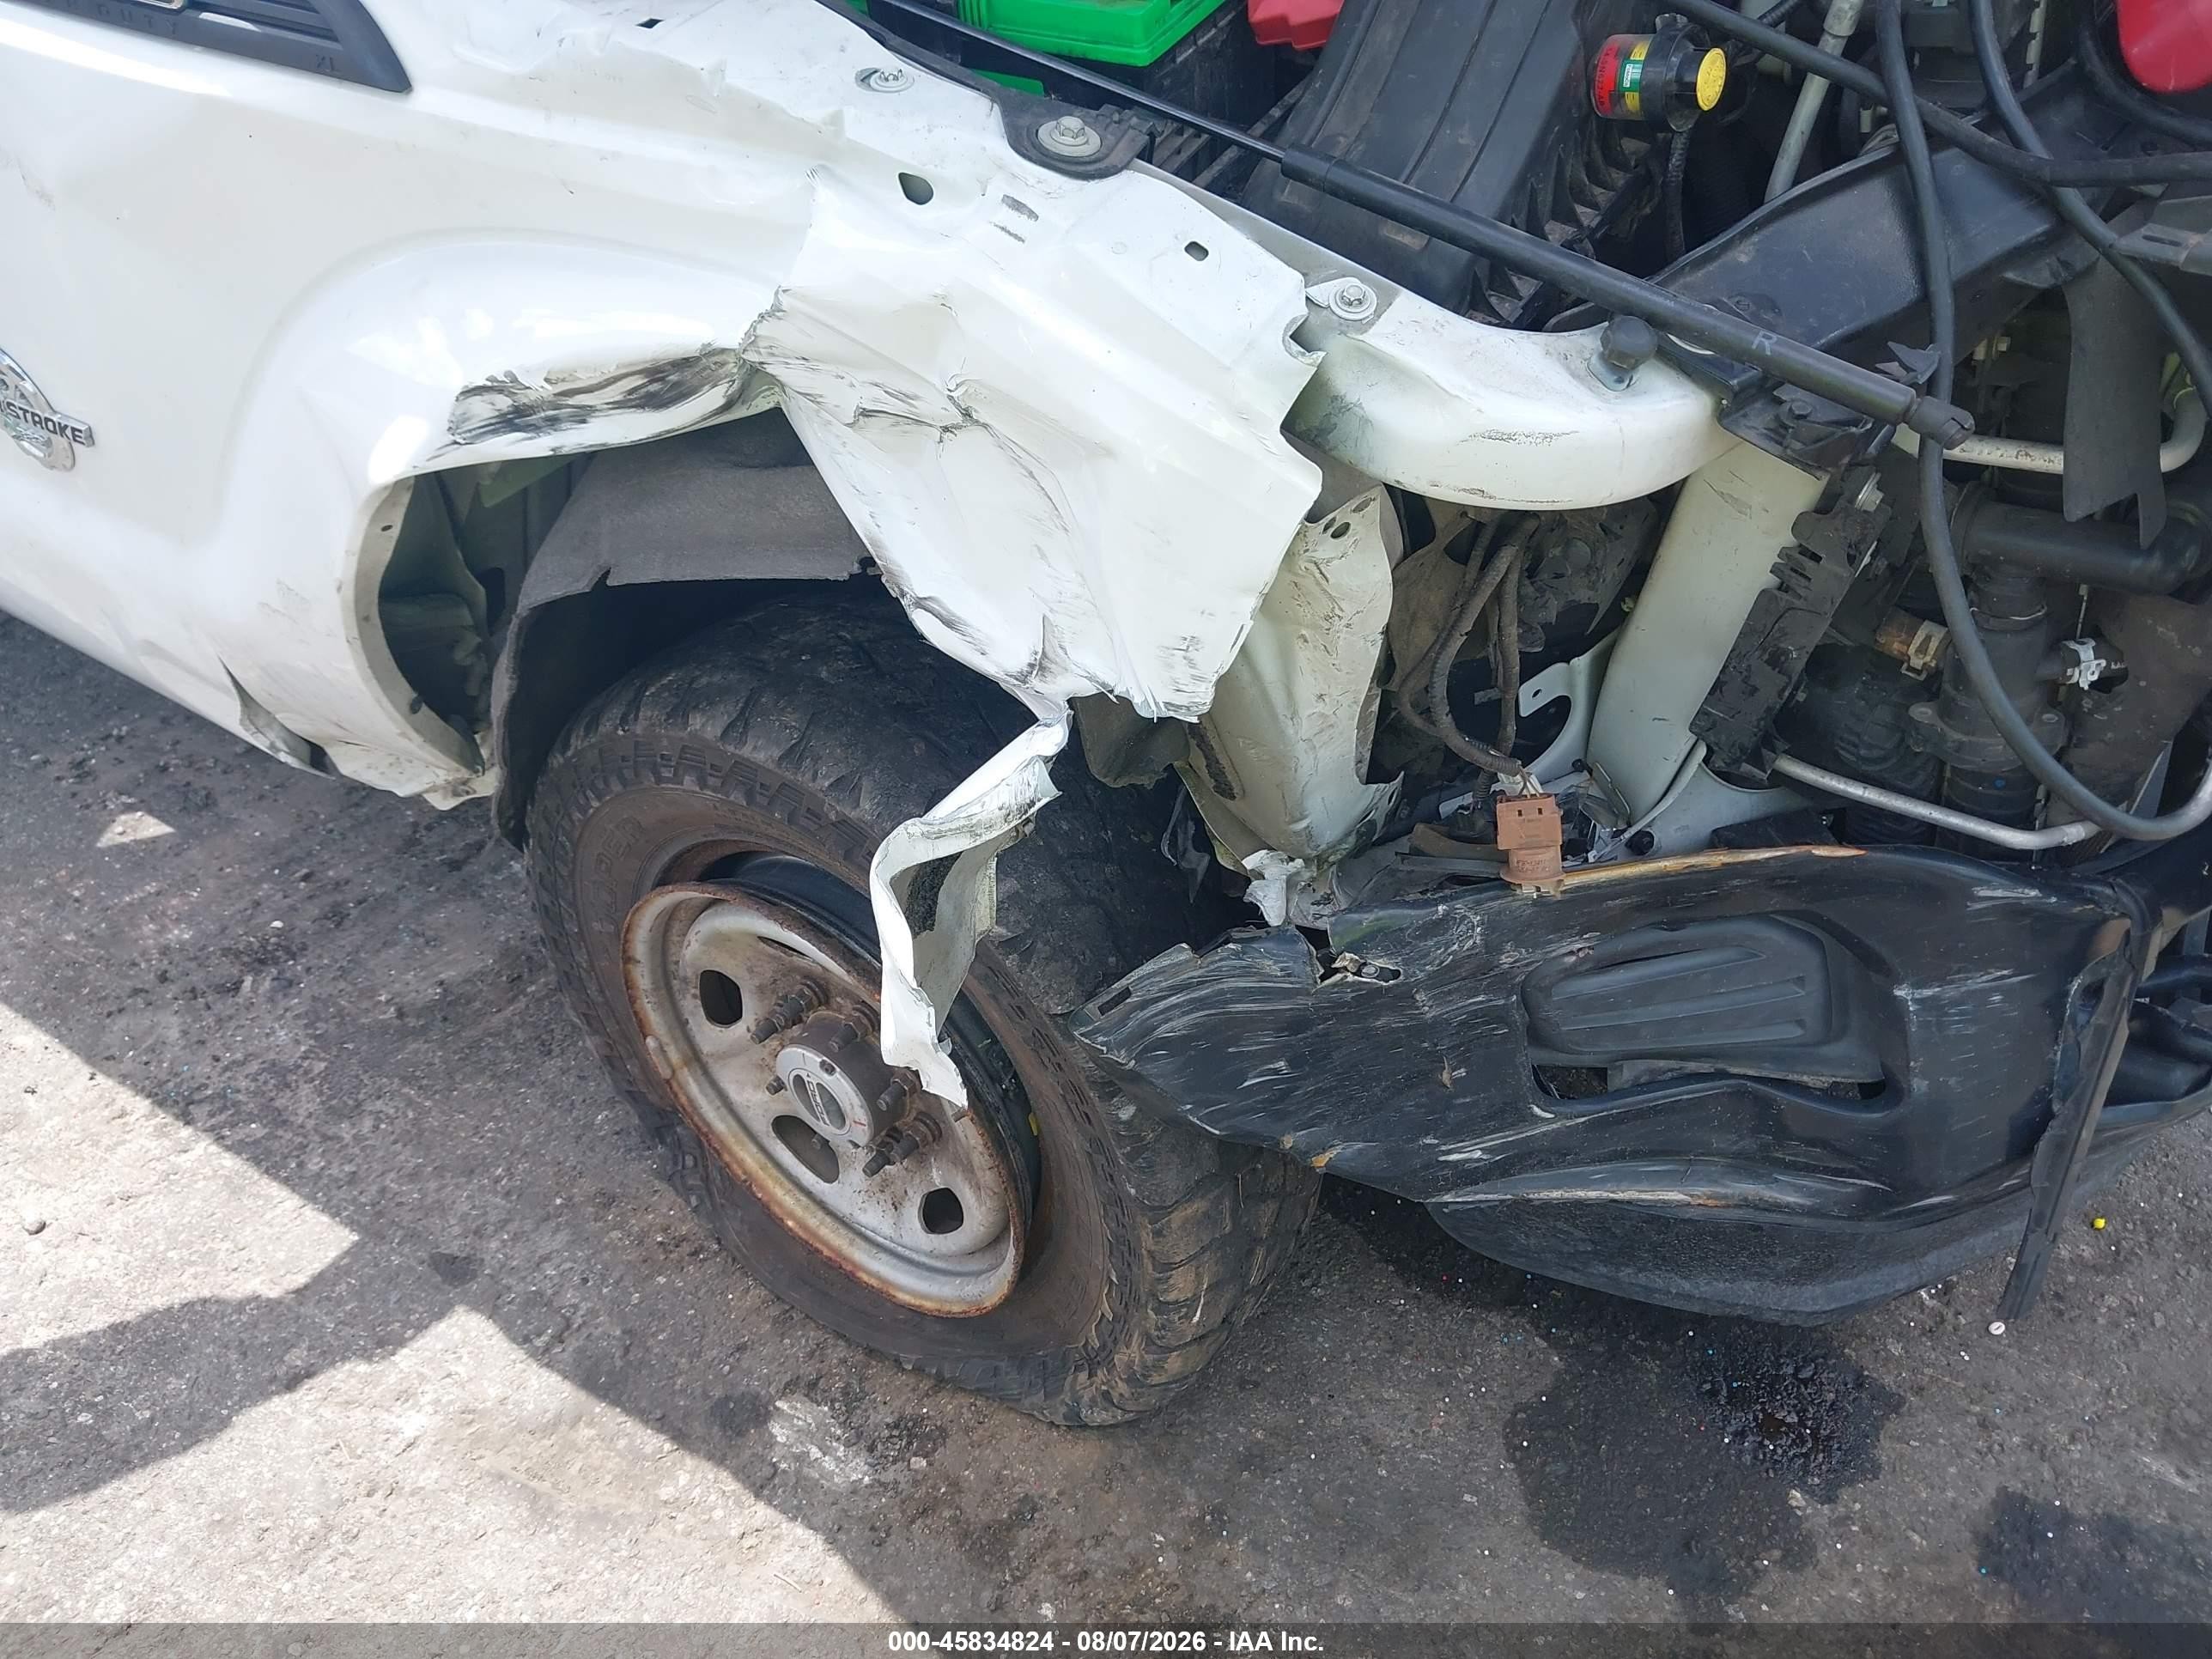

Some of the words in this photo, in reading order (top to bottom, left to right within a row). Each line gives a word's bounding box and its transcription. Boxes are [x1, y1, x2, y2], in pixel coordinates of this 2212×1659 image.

[97, 3, 177, 35] DUTY
[315, 54, 343, 73] XL
[1752, 330, 1777, 356] R
[5, 400, 86, 446] STROKE
[806, 1079, 830, 1126] FORD
